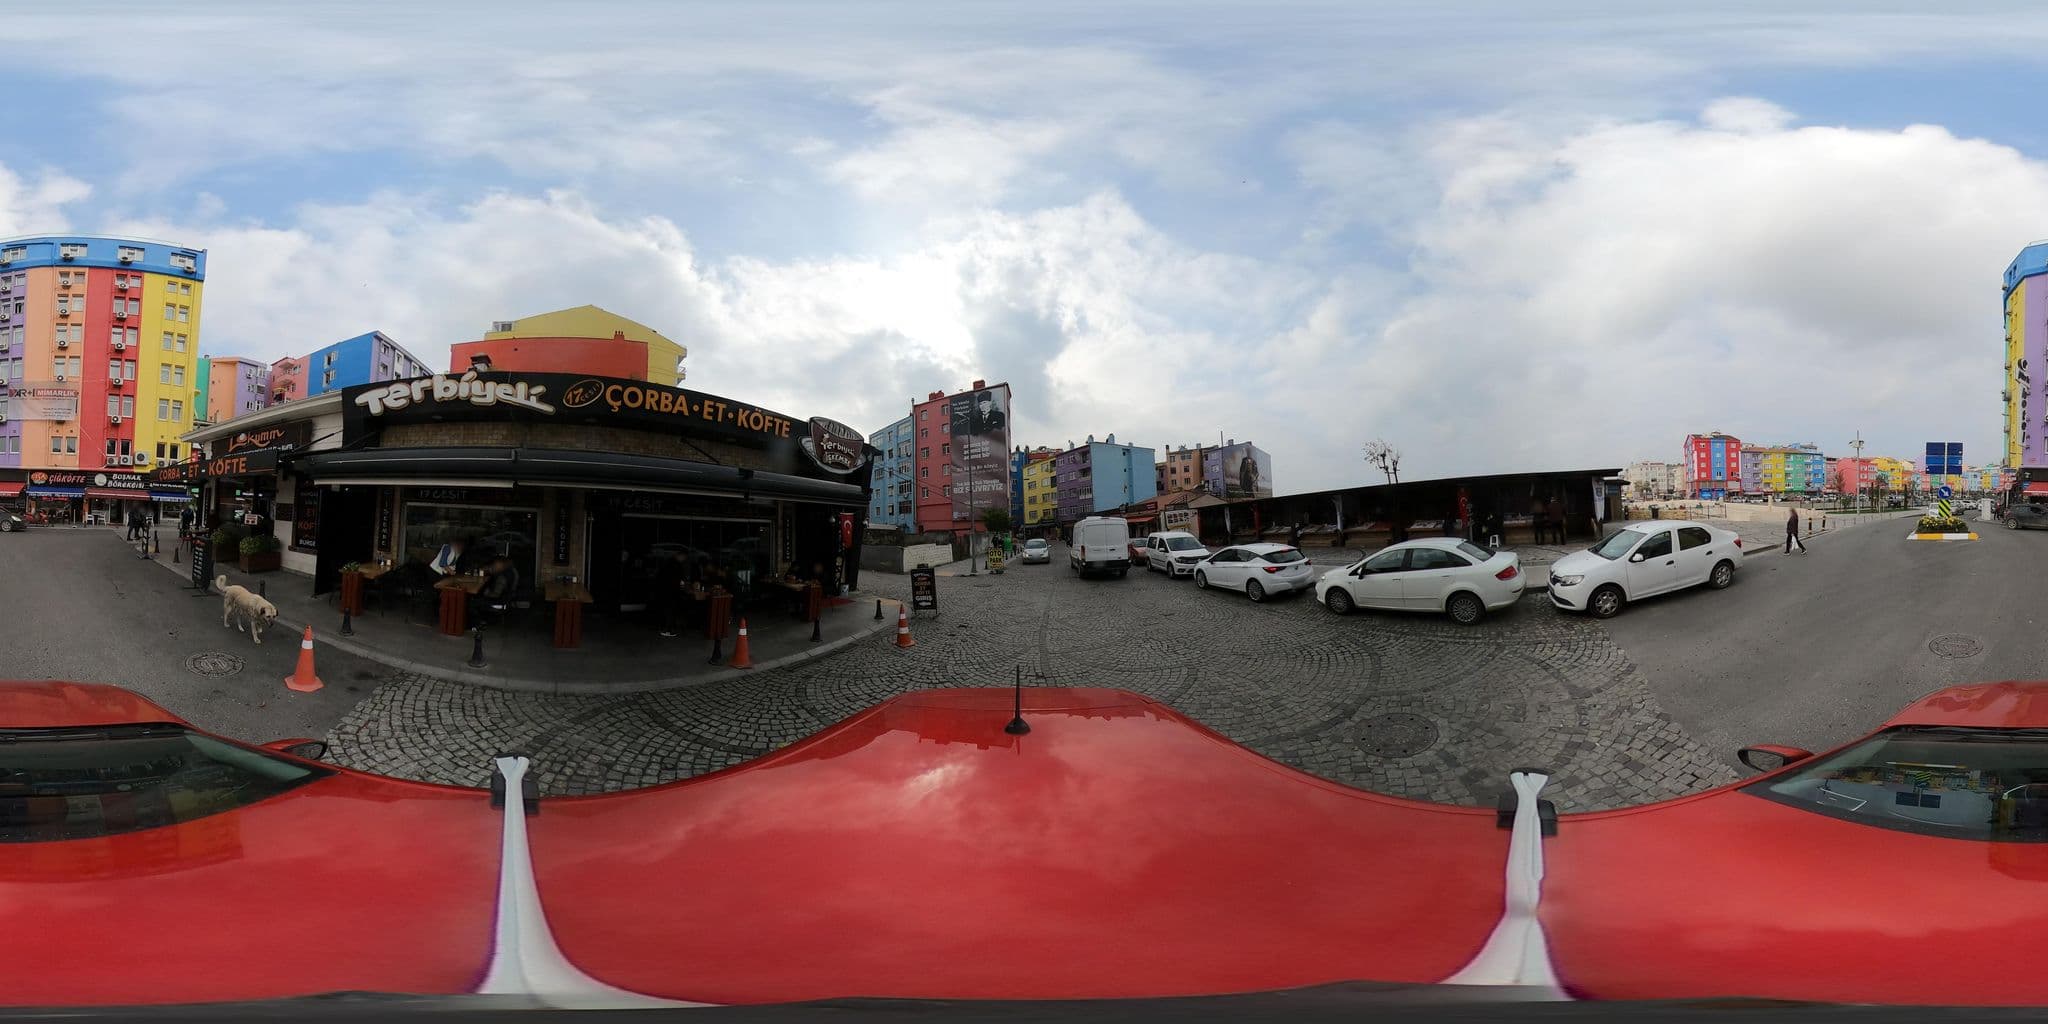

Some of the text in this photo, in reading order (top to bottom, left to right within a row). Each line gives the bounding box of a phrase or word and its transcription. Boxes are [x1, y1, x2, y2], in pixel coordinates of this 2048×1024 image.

[566, 388, 583, 404] 17
[605, 384, 791, 438] ÇORBA ET KÖFTE
[188, 464, 199, 478] ET
[208, 456, 247, 476] KÖFTE
